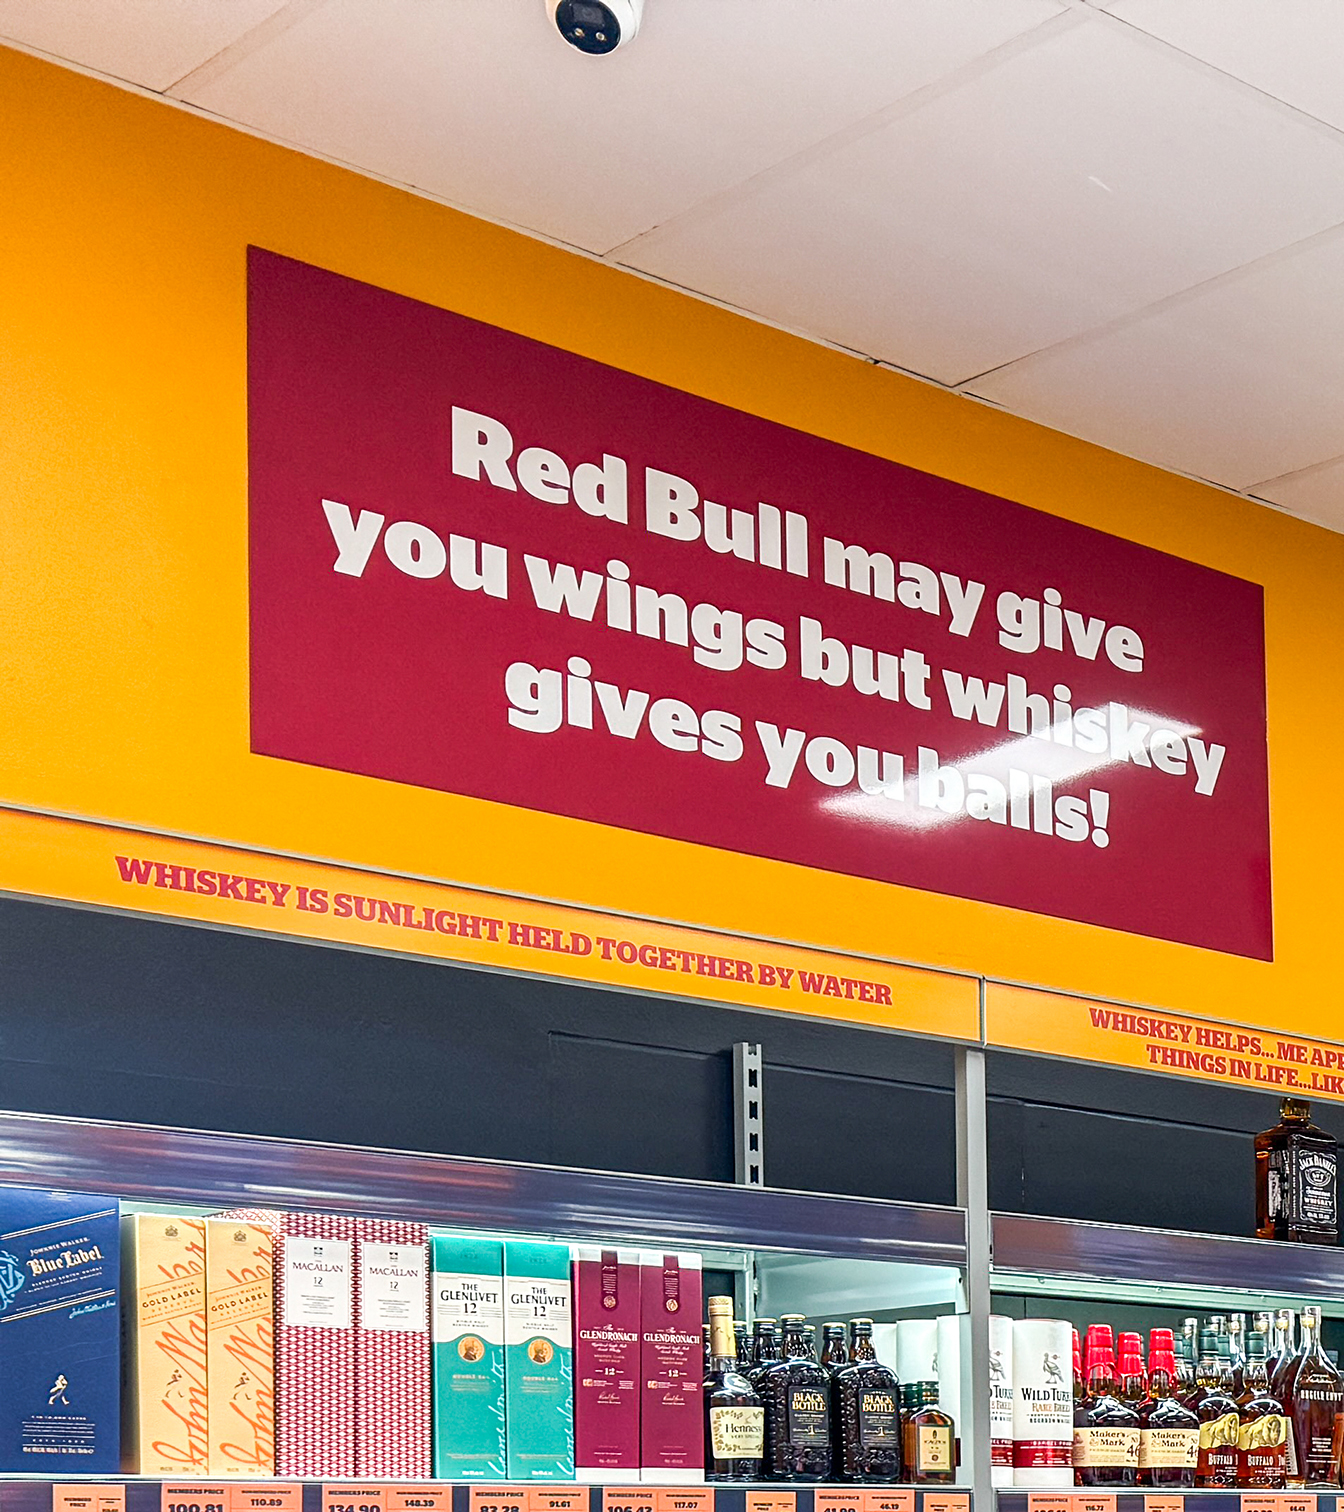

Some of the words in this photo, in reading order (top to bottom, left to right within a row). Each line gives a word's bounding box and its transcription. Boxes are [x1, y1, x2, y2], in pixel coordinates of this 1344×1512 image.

[452, 405, 627, 523] Red
[645, 466, 808, 579] Bull
[824, 537, 986, 637] may
[997, 587, 1144, 673] give
[322, 498, 508, 600] you
[526, 552, 787, 671] wings
[800, 617, 930, 710] but
[942, 668, 1227, 796] whiskey
[505, 656, 745, 764] gives
[755, 717, 906, 800] you
[916, 746, 1110, 848] balls!
[115, 856, 290, 907] WHISKEY
[296, 884, 328, 914] IS
[333, 893, 503, 943] SUNLIGHT
[507, 921, 591, 957] HELD
[596, 936, 753, 985] TOGETHER
[757, 962, 795, 991] BY
[797, 971, 893, 1006] WATER
[1089, 1008, 1193, 1044] WHISKEY
[1196, 1026, 1275, 1060] HELPS...
[1277, 1042, 1307, 1063] ME
[1147, 1044, 1226, 1076] THINGS
[1230, 1060, 1252, 1079] IN
[292, 1261, 343, 1274] MACALLAN
[440, 1291, 499, 1304] GLENLIVET
[579, 1328, 638, 1343] GLENDRONACH
